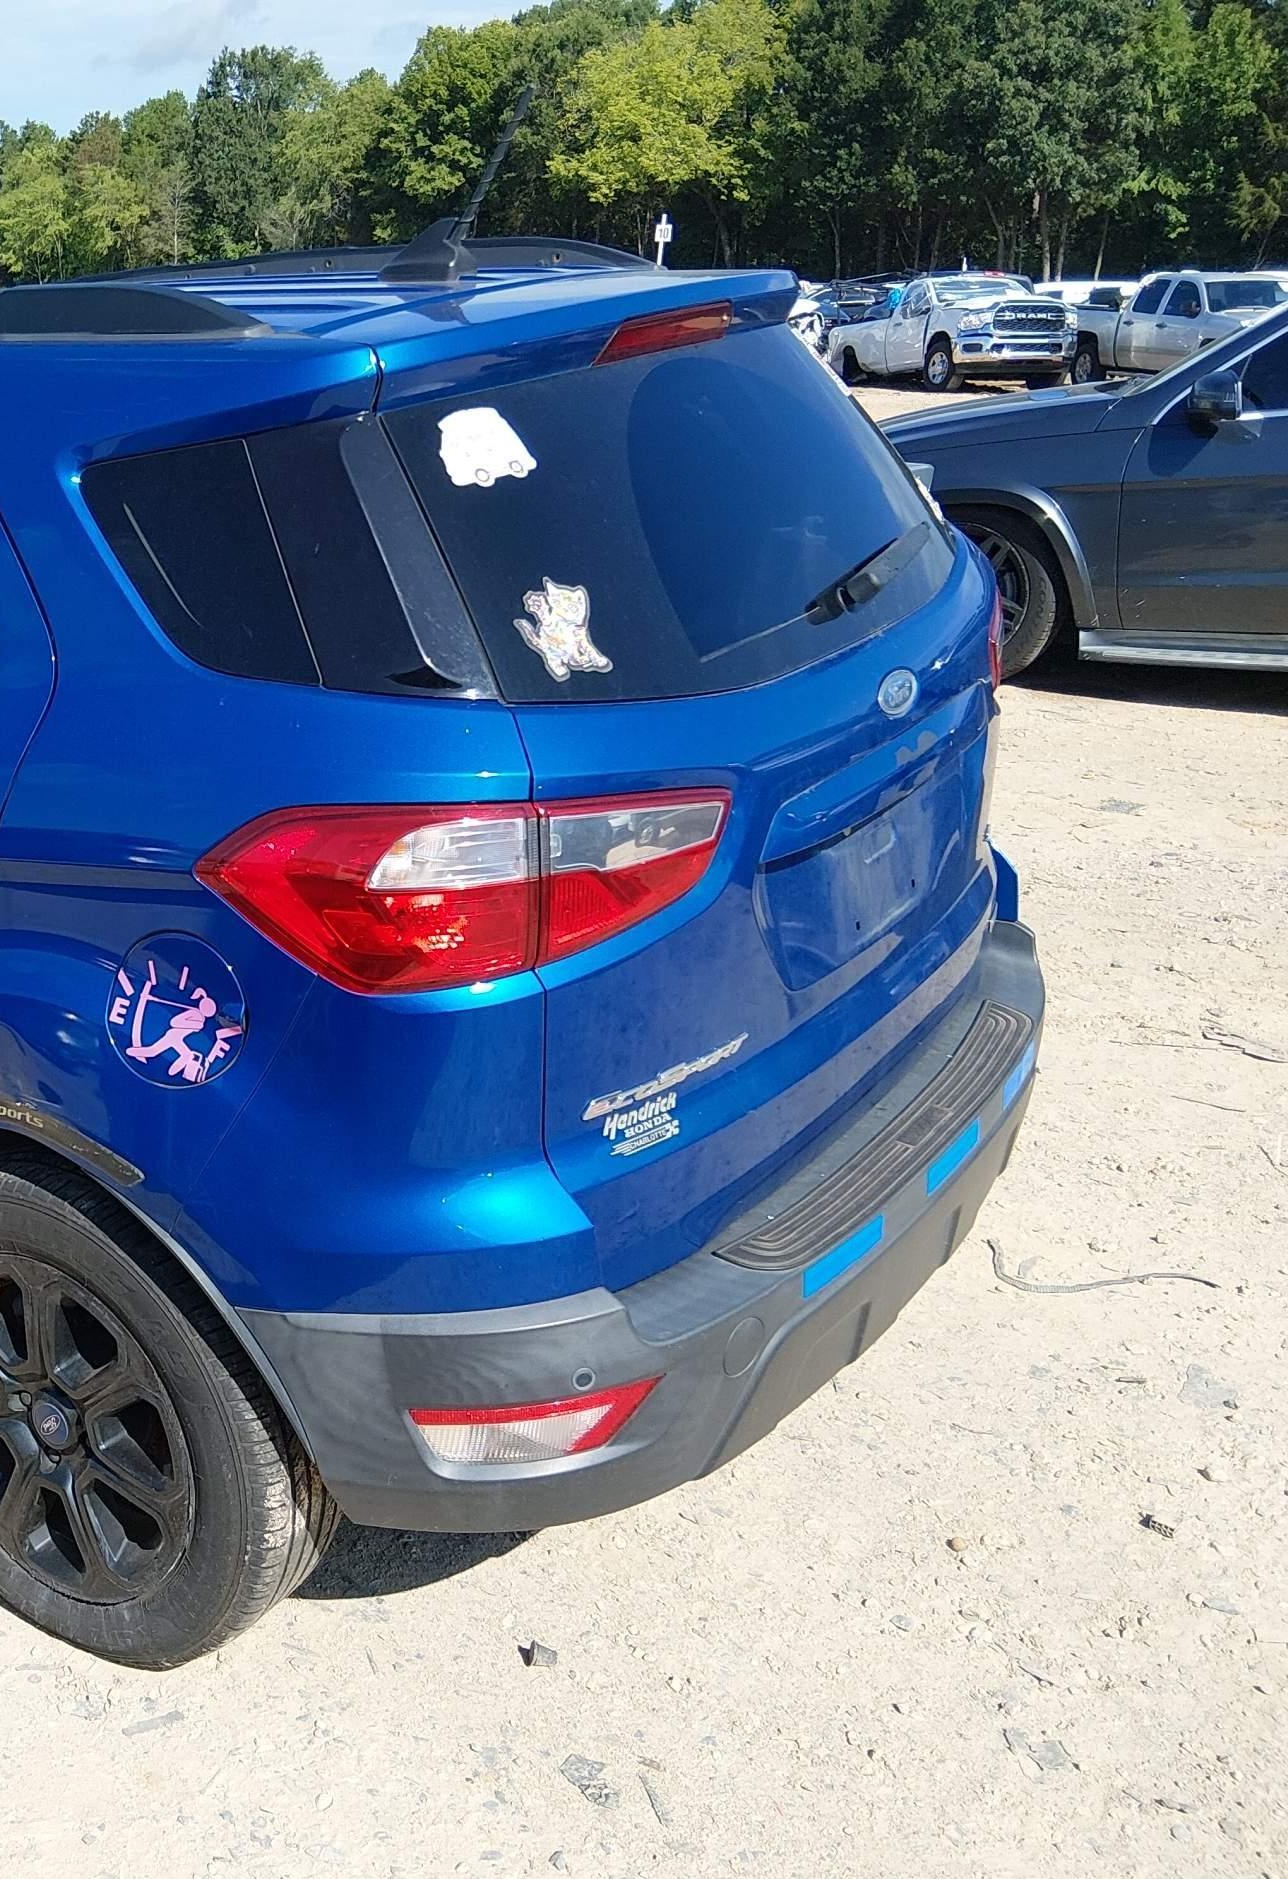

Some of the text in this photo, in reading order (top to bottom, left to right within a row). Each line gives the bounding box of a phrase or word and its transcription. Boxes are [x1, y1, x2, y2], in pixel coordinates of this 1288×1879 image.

[1016, 312, 1047, 320] RAM
[109, 997, 130, 1025] E
[208, 1039, 230, 1063] F
[624, 1113, 672, 1138] HONDA
